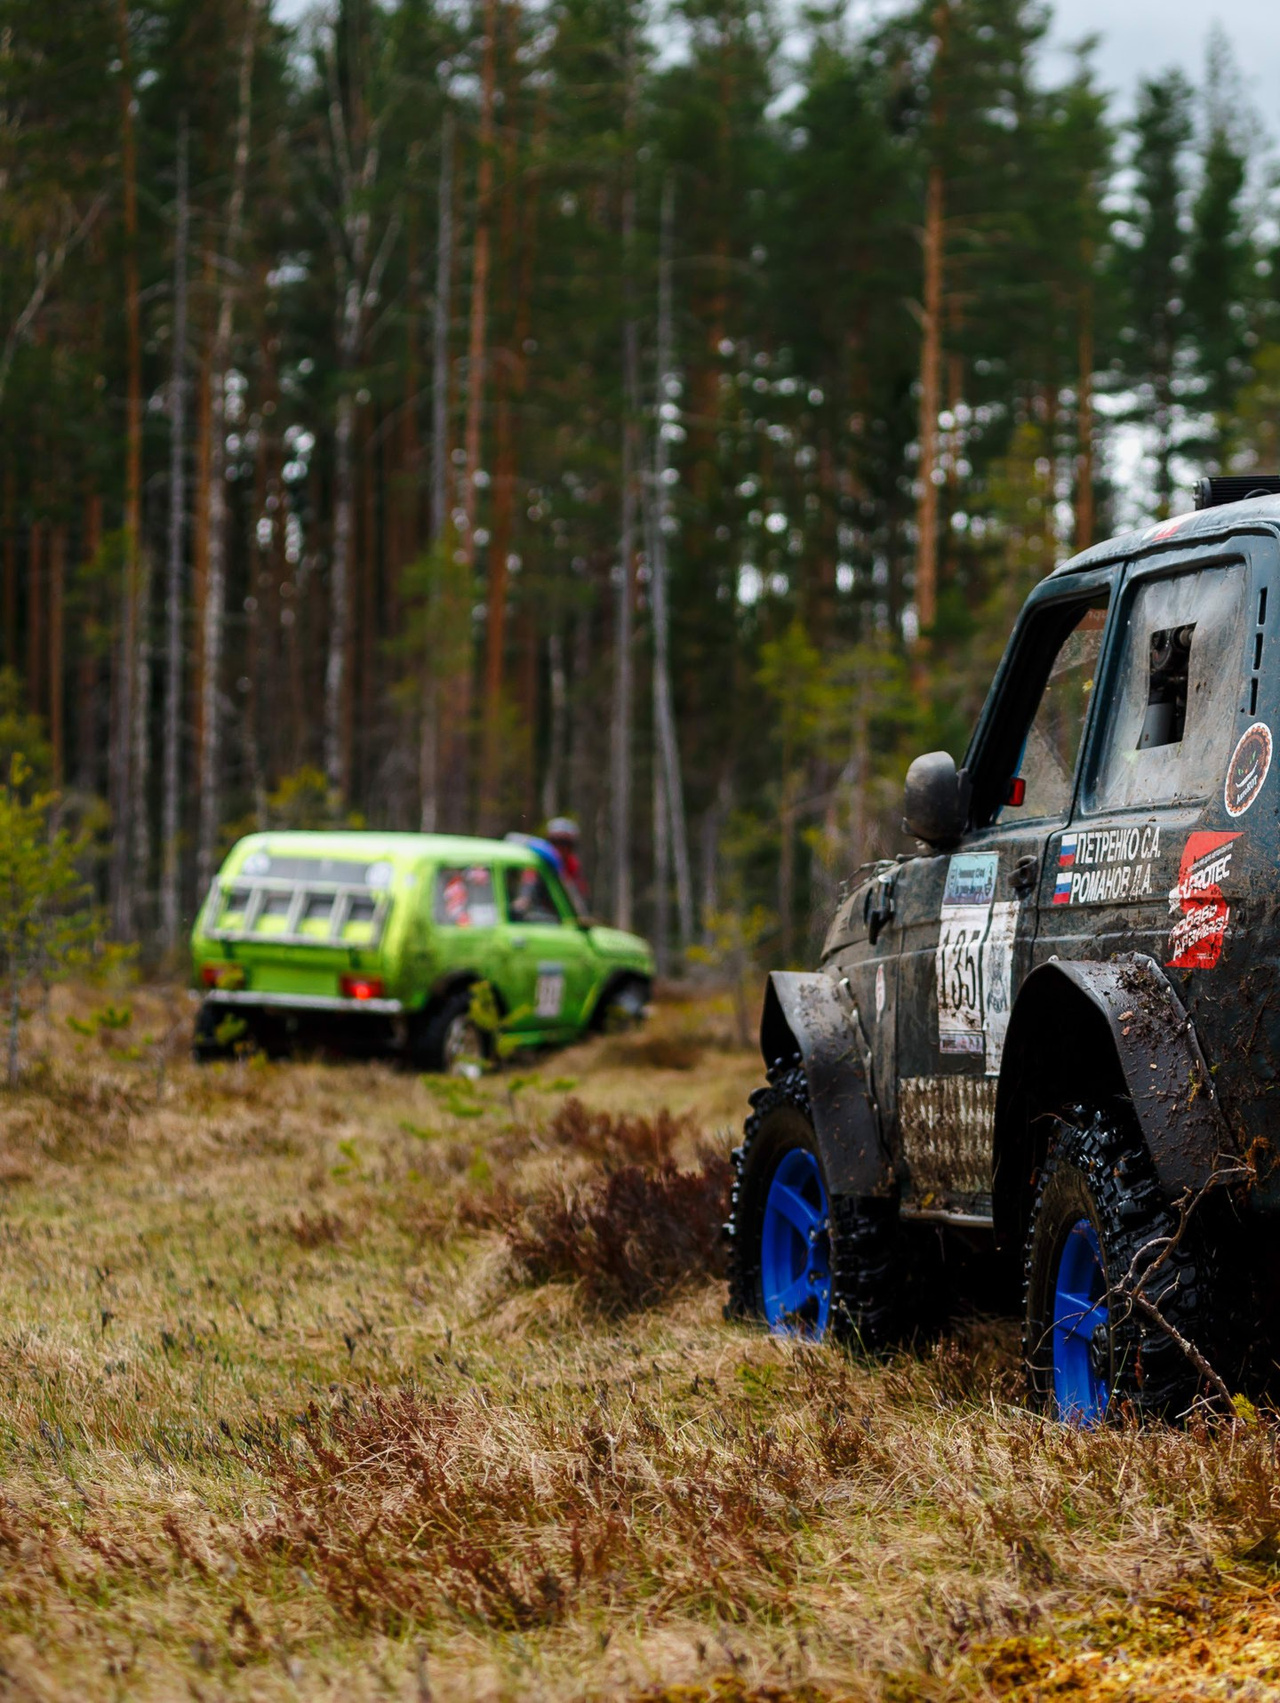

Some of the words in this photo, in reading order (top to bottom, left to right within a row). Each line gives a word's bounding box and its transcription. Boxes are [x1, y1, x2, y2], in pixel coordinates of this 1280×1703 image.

[1075, 827, 1140, 864] ПЕТРЕНКО
[1140, 826, 1161, 859] С.А.
[1069, 866, 1131, 904] РОМАНОВ
[1128, 863, 1152, 901] Д.А.
[939, 928, 982, 1011] 135
